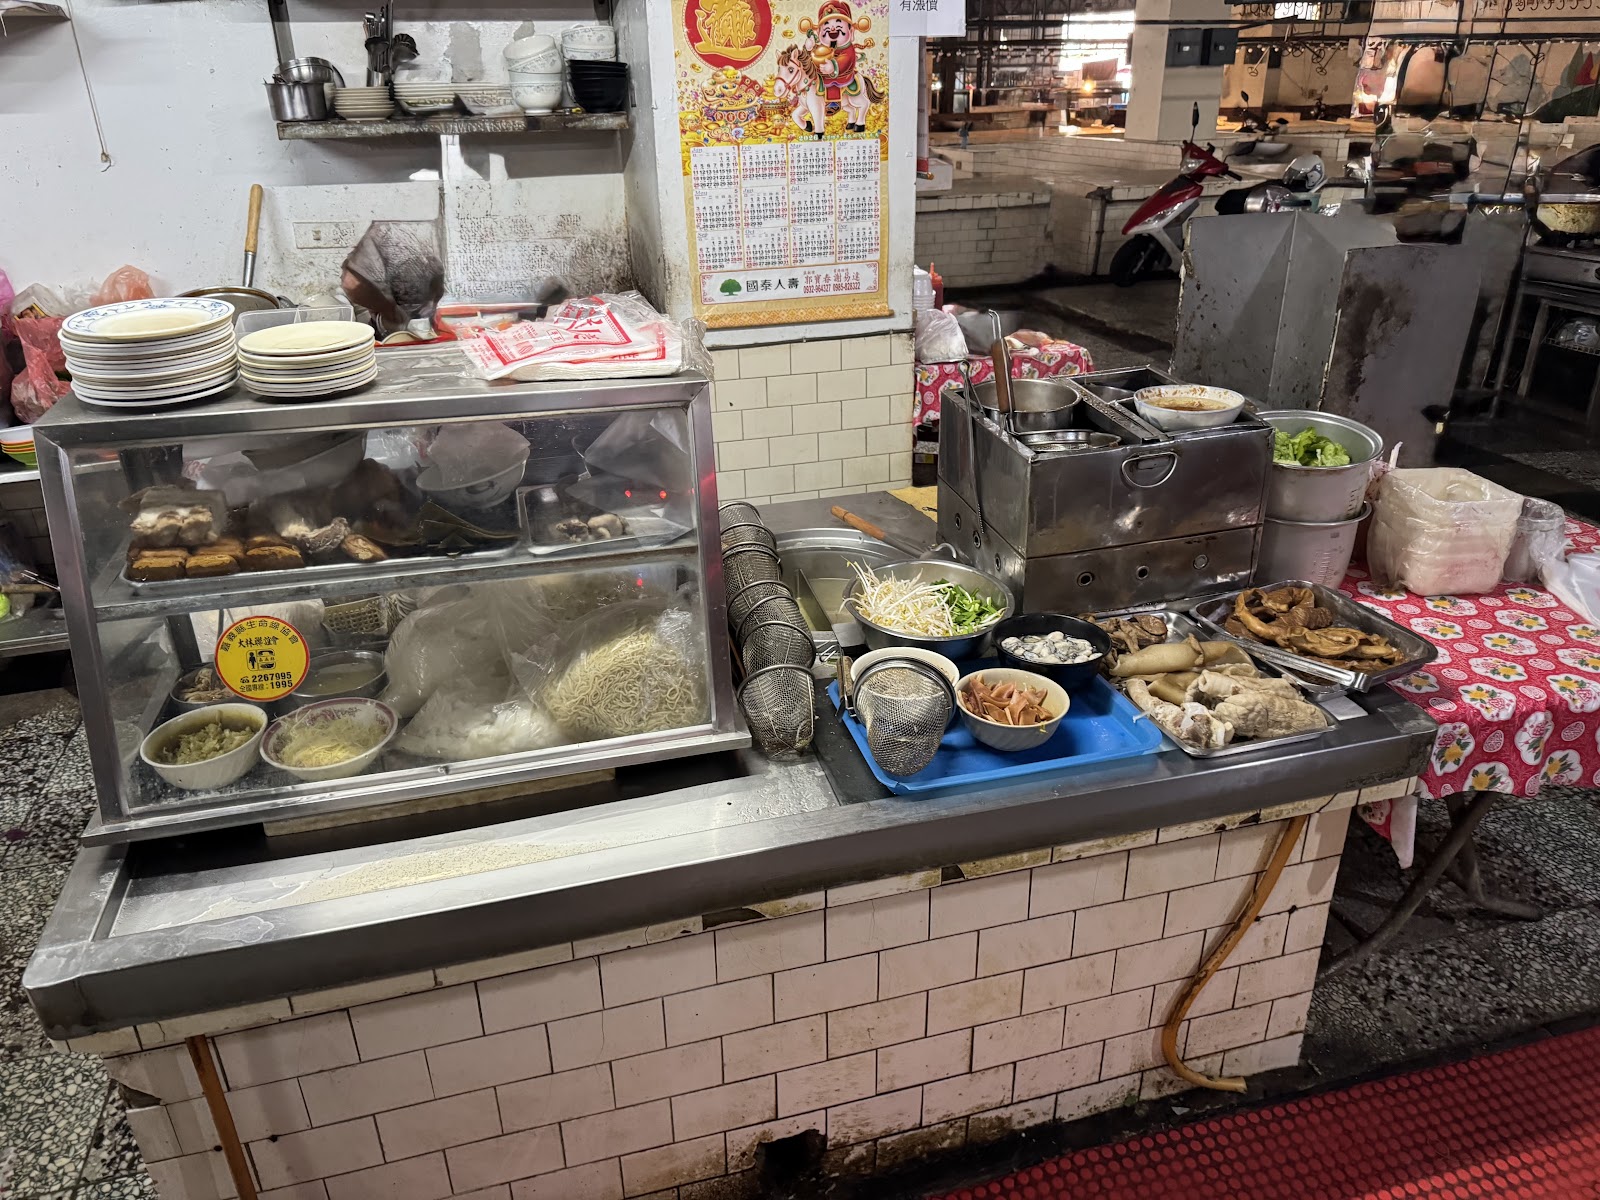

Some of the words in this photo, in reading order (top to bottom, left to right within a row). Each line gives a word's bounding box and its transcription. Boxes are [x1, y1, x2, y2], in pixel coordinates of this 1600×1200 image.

[746, 278, 799, 292] 國泰人壽
[221, 619, 298, 651] 嘉義縣生命線協會
[238, 636, 279, 648] 大林聯誼會
[252, 672, 291, 682] 2267995
